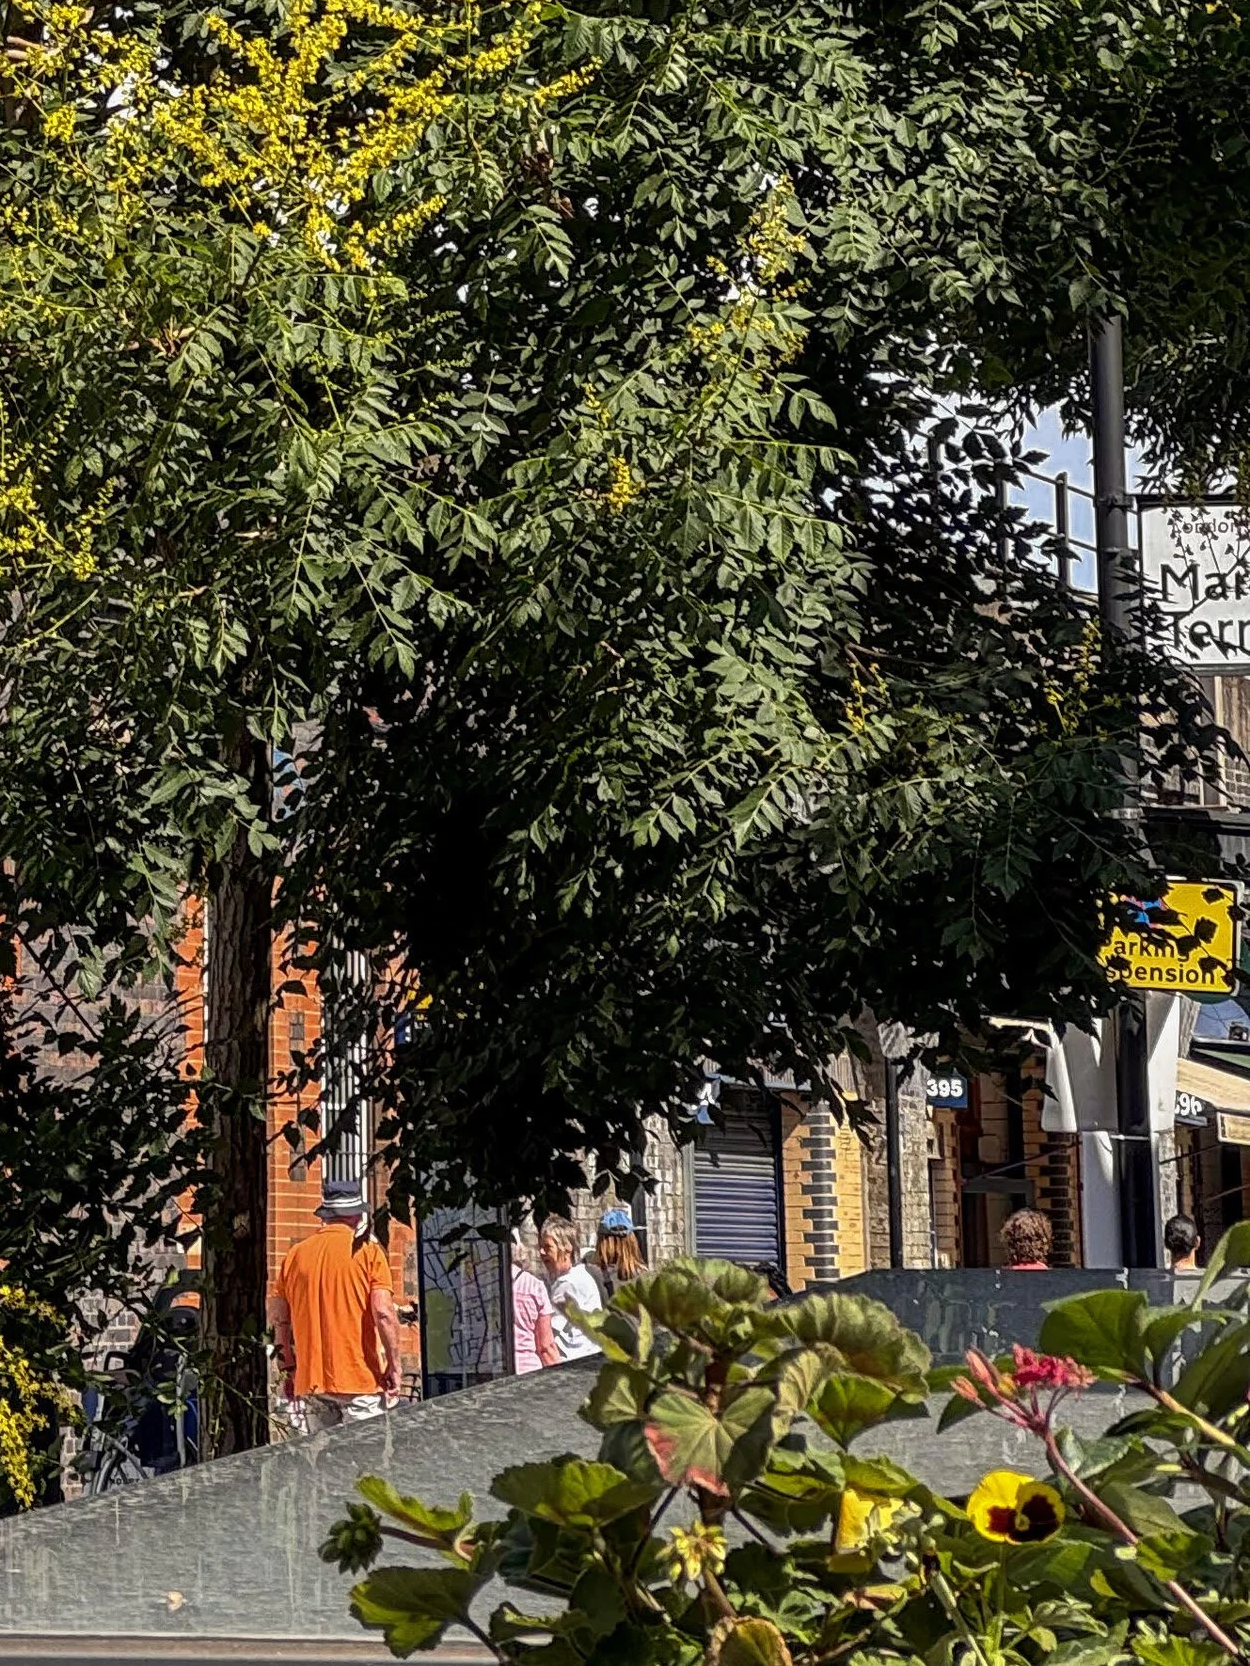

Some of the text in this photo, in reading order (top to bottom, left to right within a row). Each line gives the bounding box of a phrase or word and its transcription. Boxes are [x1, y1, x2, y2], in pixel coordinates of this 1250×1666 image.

[1113, 935, 1190, 962] arkin
[1106, 964, 1215, 985] spension
[926, 1079, 963, 1097] 395
